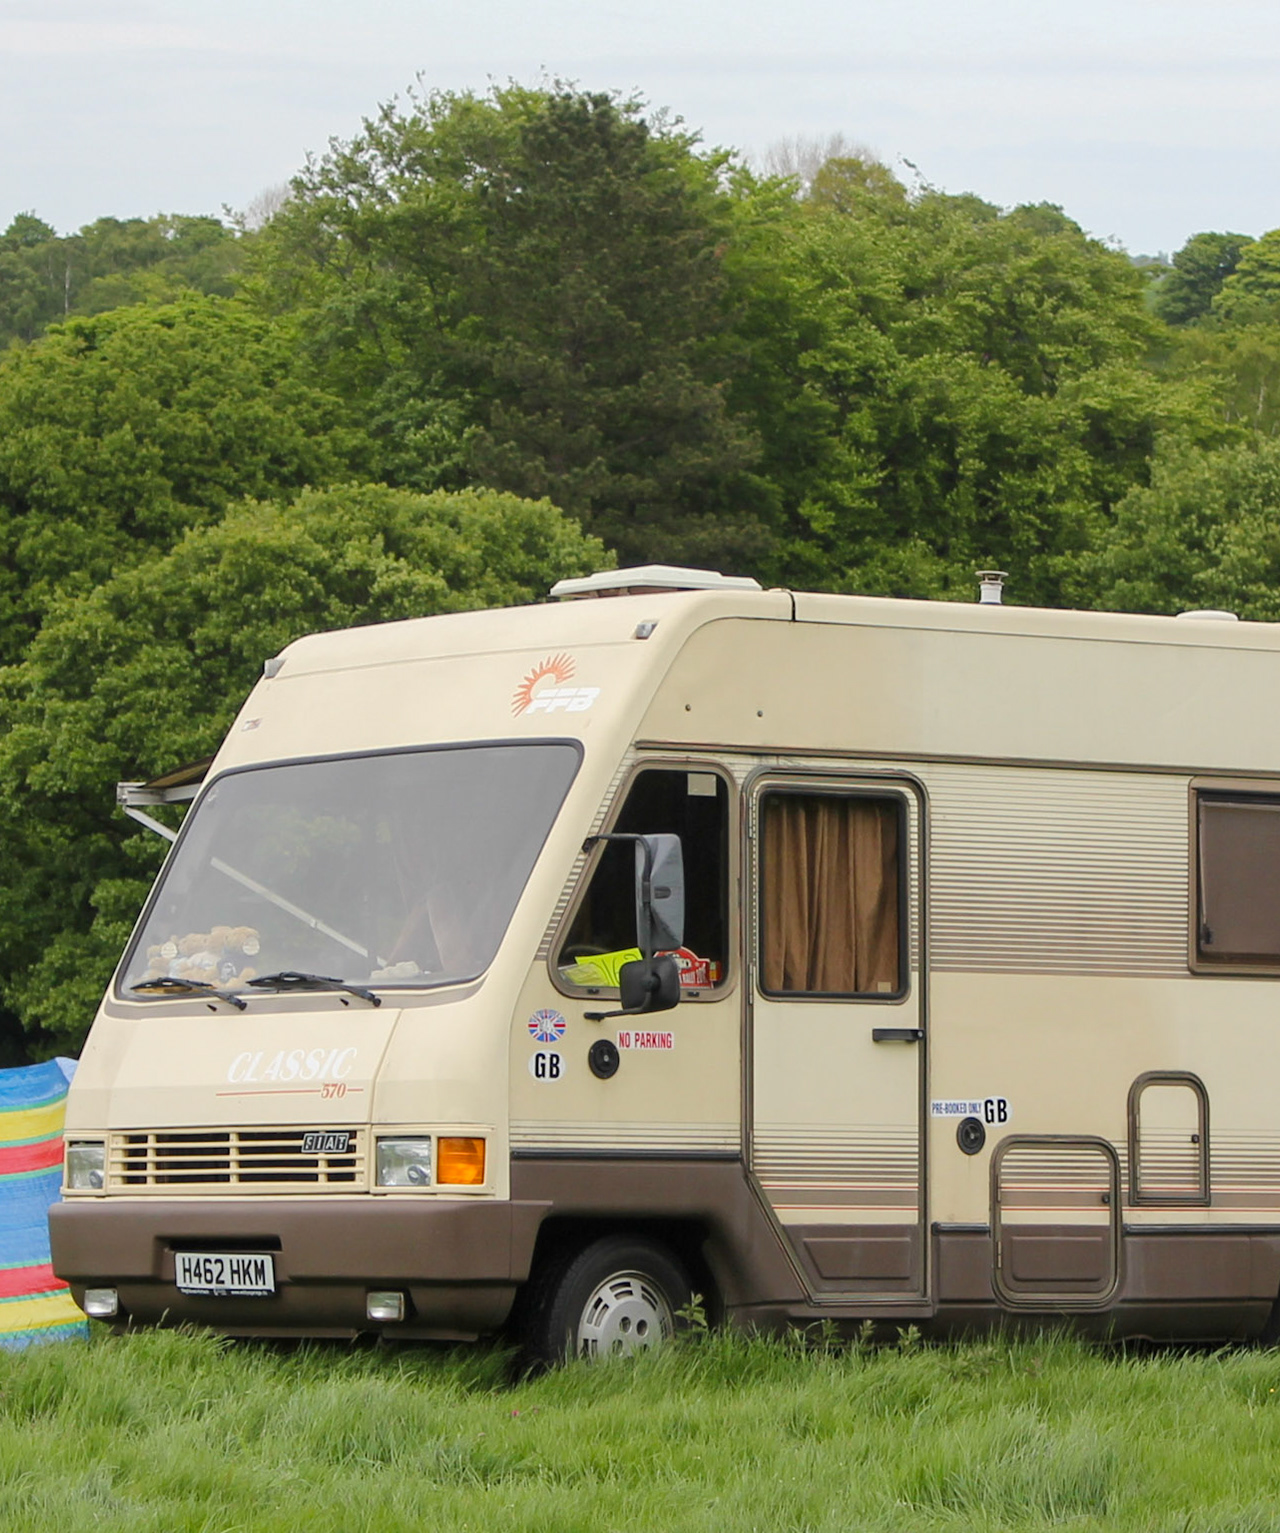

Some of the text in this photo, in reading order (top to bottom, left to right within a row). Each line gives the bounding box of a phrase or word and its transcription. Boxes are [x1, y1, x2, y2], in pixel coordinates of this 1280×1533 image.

[525, 686, 601, 714] FFB
[619, 1032, 672, 1049] NO PARKING
[227, 1047, 357, 1083] CLASSIC
[535, 1052, 560, 1079] GB
[320, 1083, 347, 1099] 570
[968, 1102, 982, 1114] ONLY
[984, 1099, 1008, 1124] GB
[304, 1135, 348, 1151] FIAT
[182, 1257, 266, 1286] H462 HKM
